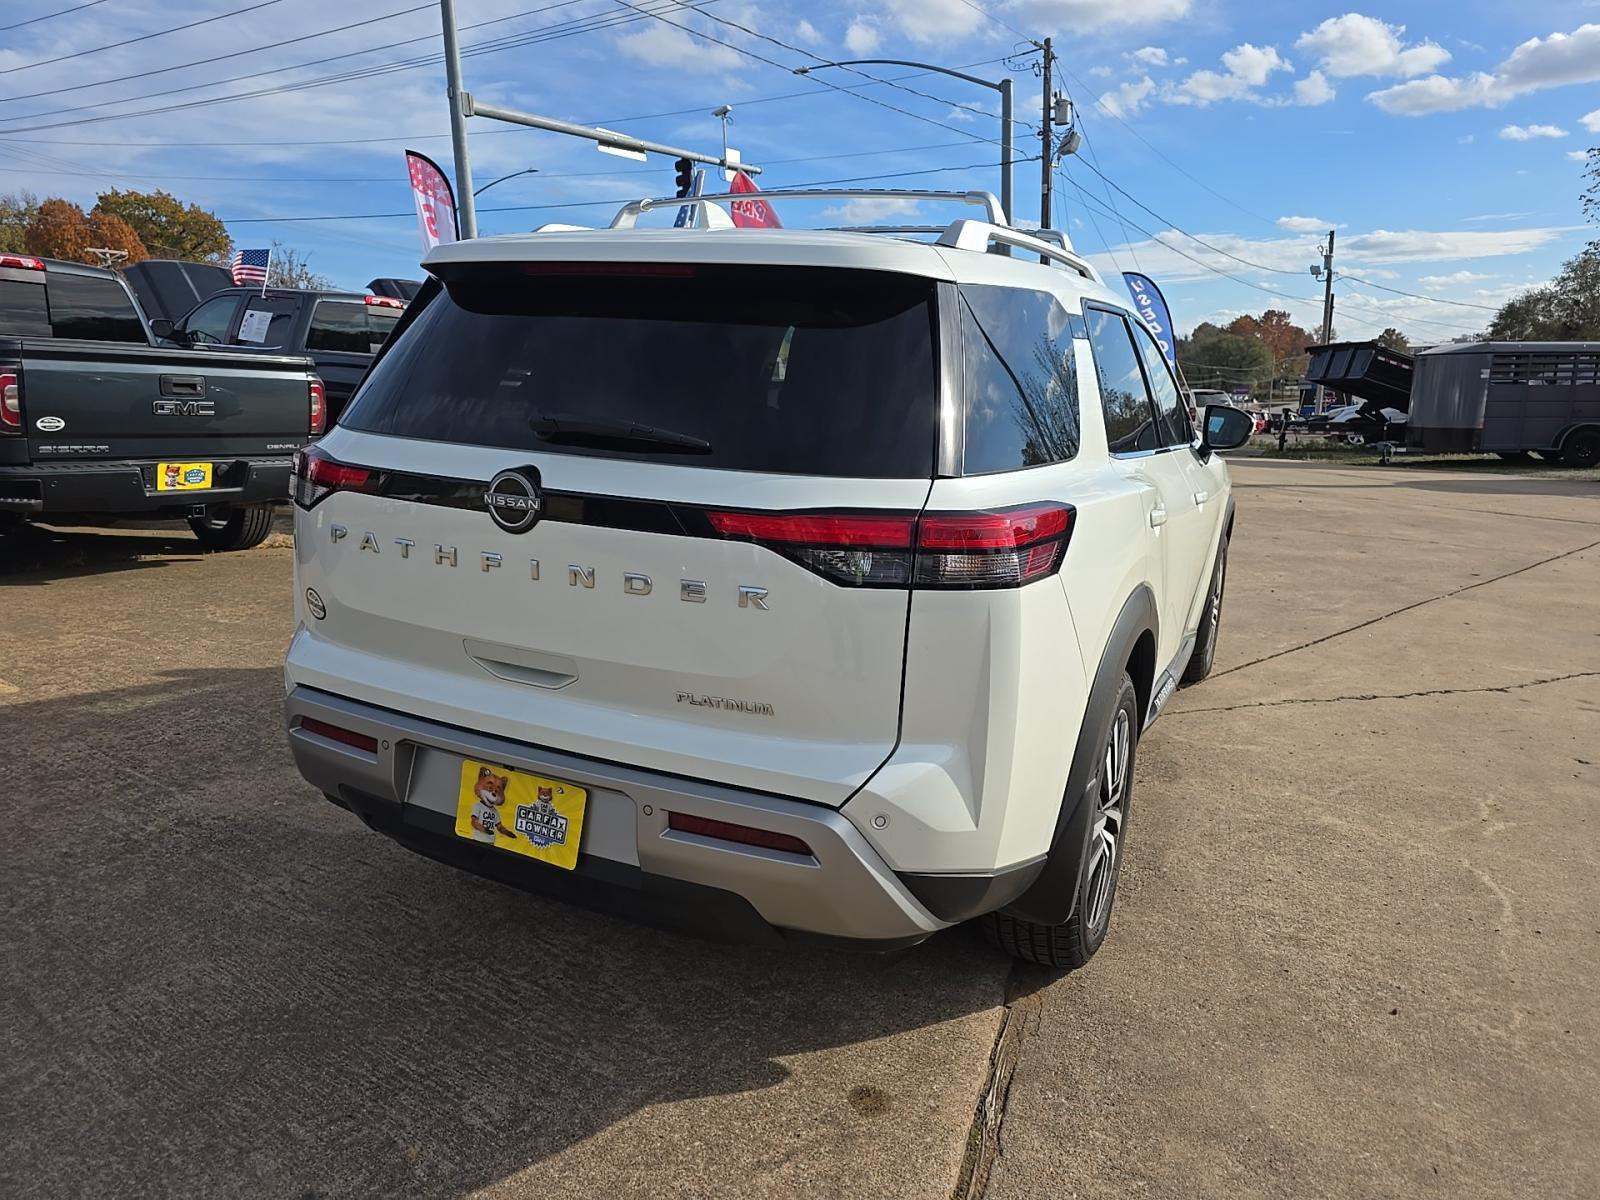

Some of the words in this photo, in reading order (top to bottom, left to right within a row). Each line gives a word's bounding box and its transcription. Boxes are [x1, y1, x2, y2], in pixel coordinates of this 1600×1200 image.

[153, 401, 215, 415] GMC
[38, 445, 110, 454] SIERRA
[484, 494, 540, 510] NISSAN
[330, 523, 770, 611] PATHFINDER
[676, 691, 775, 716] PLATINUM
[520, 807, 567, 831] CARFAX
[526, 821, 564, 840] OWNER
